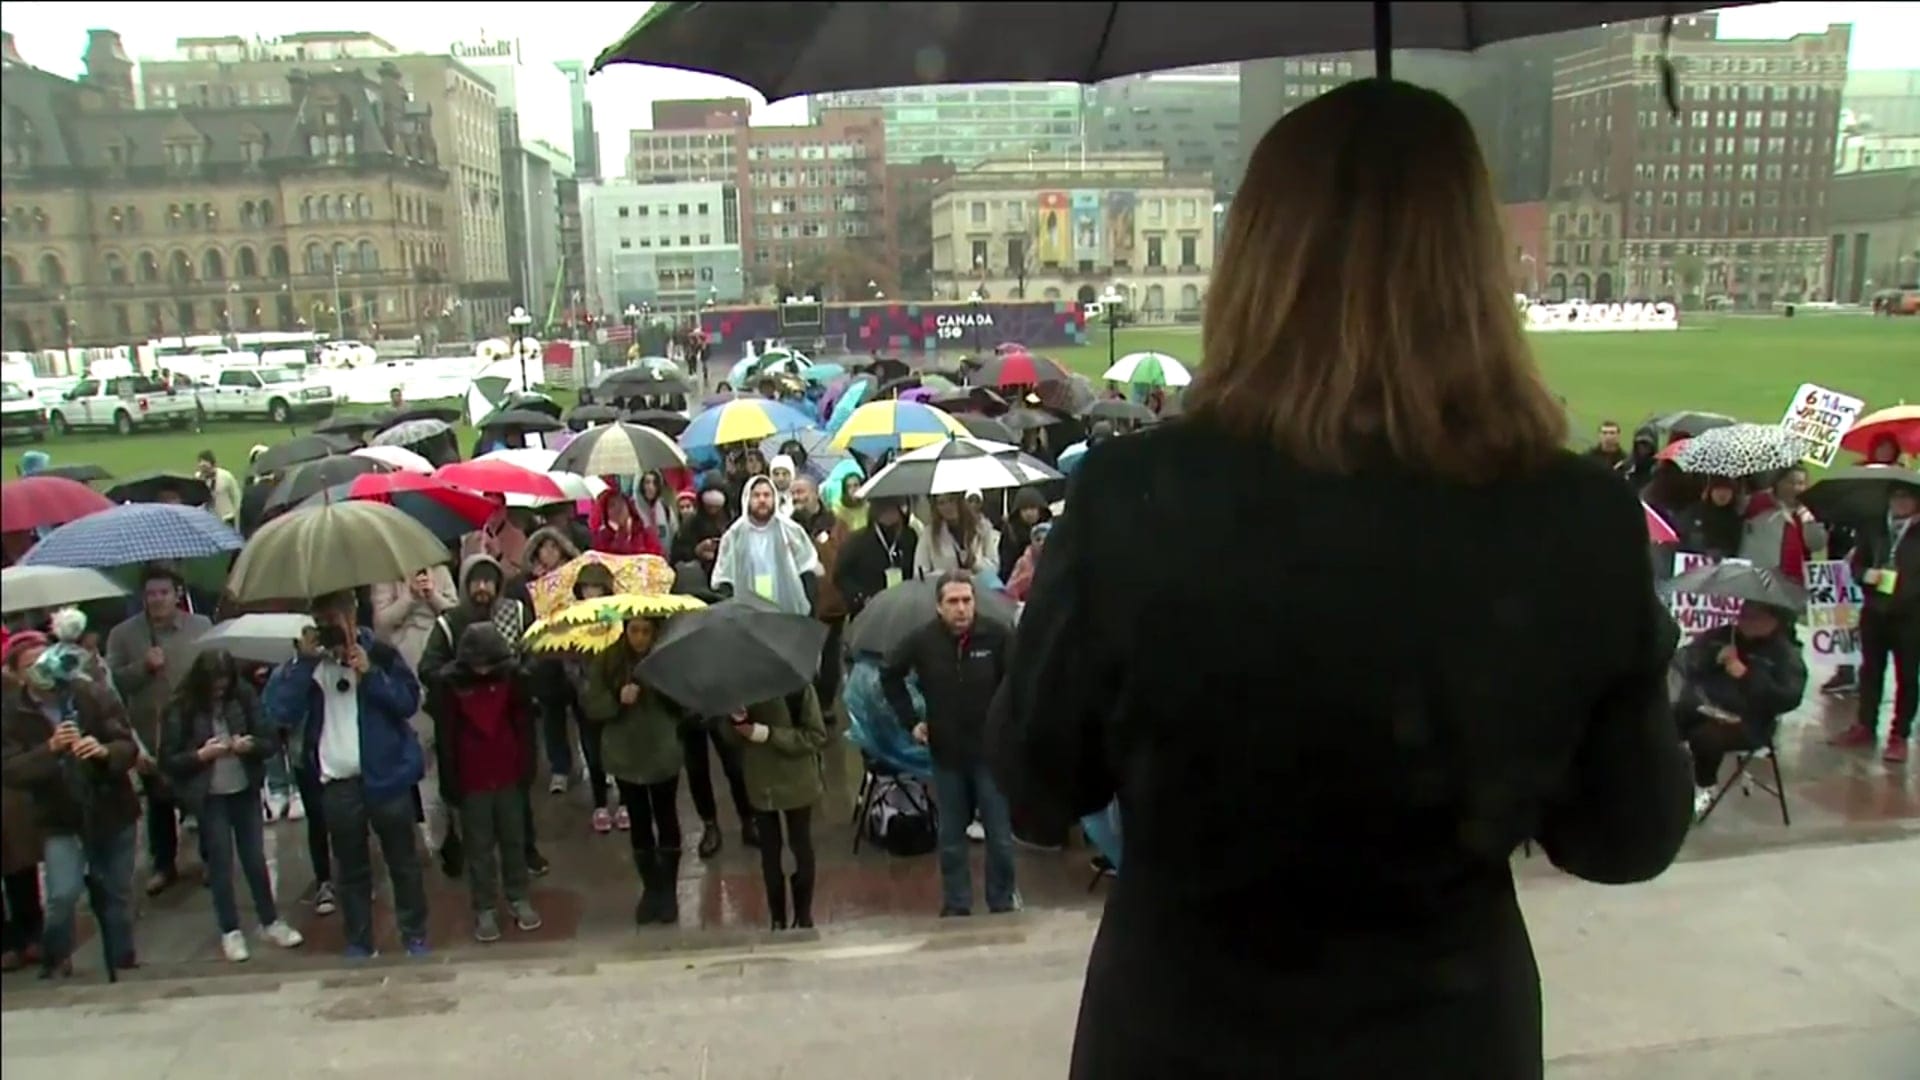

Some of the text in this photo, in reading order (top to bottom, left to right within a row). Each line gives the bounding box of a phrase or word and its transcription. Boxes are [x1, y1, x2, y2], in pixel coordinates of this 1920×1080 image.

[936, 313, 994, 327] CANADA
[937, 326, 963, 339] 150
[1806, 390, 1818, 405] 6
